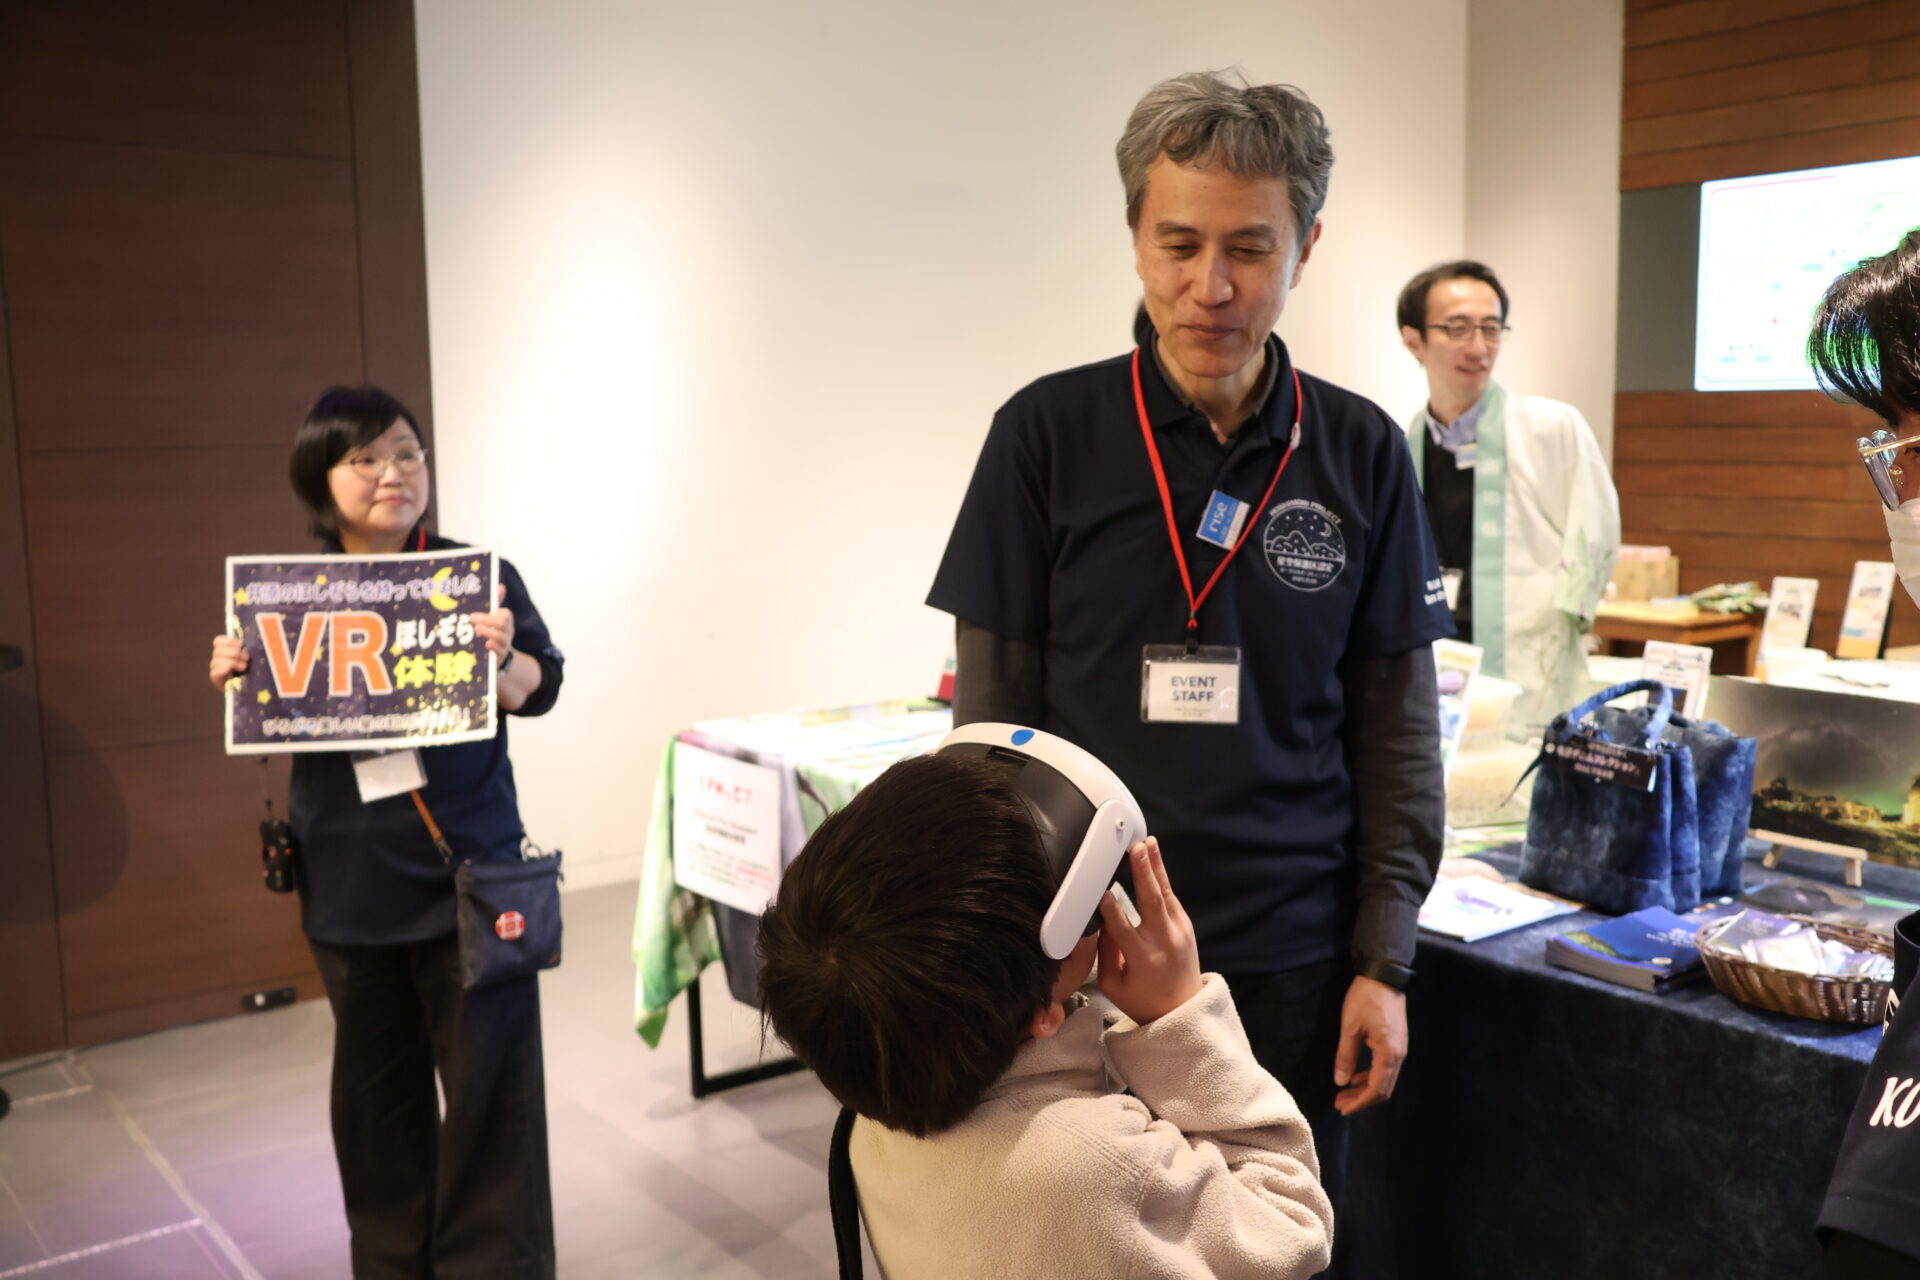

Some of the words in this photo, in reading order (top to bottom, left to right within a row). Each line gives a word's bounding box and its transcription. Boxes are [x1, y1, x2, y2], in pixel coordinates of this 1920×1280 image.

[1209, 502, 1228, 533] rise
[396, 613, 476, 649] ほしぞら
[255, 611, 393, 698] VR
[394, 650, 477, 689] 体験
[1171, 675, 1217, 687] EVENT
[1172, 690, 1215, 702] STAFF
